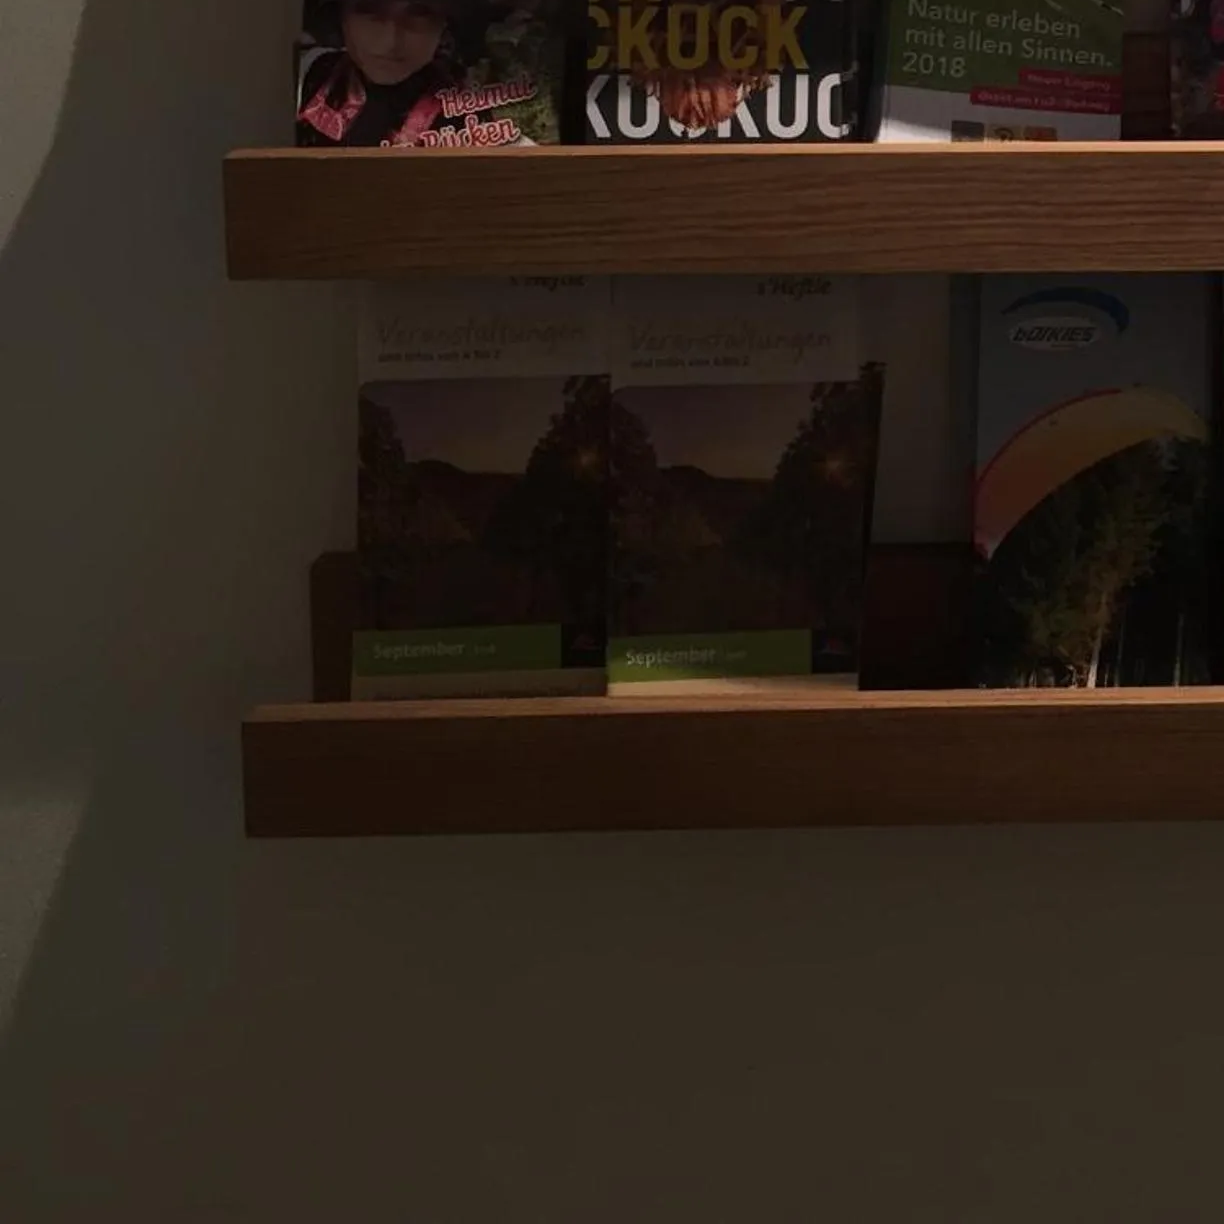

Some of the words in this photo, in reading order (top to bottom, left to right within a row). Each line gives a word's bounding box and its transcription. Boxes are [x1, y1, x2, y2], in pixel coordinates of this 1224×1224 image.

[985, 8, 1082, 40] erleben
[904, 26, 947, 49] mit
[953, 29, 1014, 57] allen
[1020, 37, 1114, 68] Sinnen.
[901, 51, 967, 78] 2018
[373, 640, 466, 661] September
[625, 645, 717, 668] September
